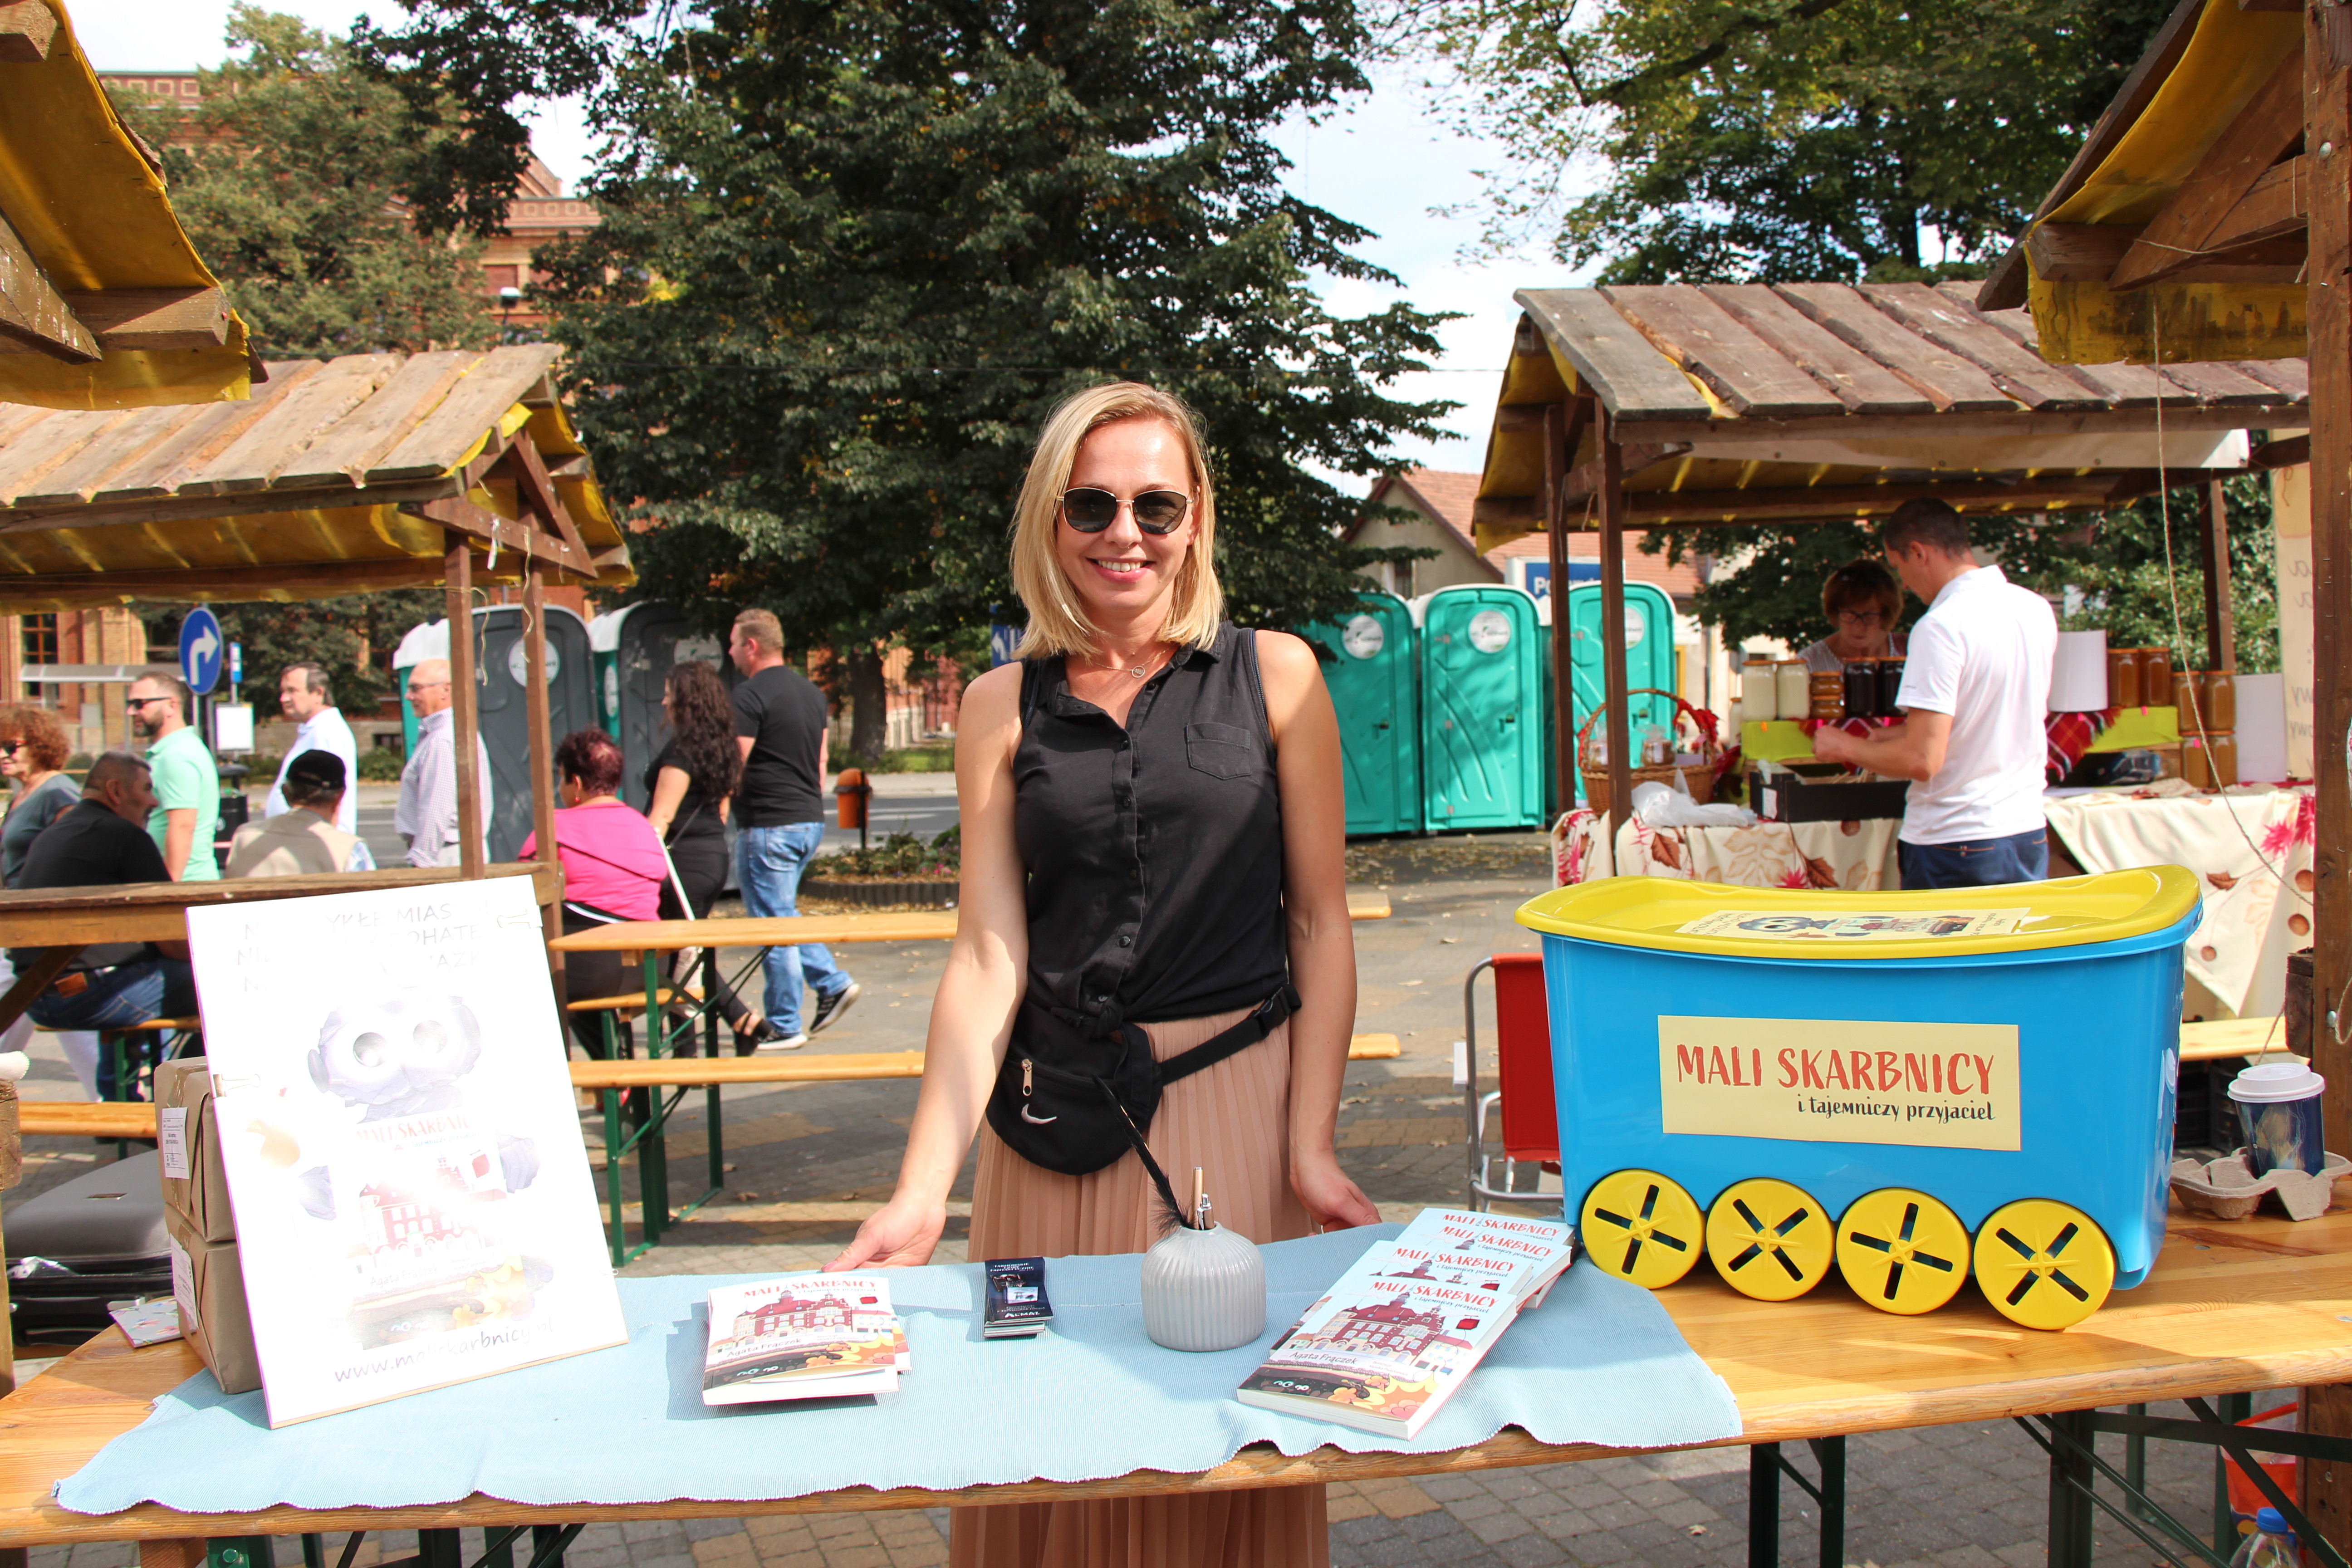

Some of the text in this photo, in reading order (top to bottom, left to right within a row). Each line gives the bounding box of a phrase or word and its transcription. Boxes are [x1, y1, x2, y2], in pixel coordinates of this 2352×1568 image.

[1676, 1044, 1994, 1095] MALI SKARBNICY
[1797, 1094, 1995, 1124] i tajemniczy przyjaciel
[397, 1116, 472, 1139] SKARBNIC
[1442, 1214, 1476, 1225] MALI
[1481, 1219, 1560, 1237] SKARBNICY
[1440, 1226, 1555, 1257] MALI SKARBNICY
[1393, 1248, 1519, 1272] MALI SKARBNICY
[1481, 1244, 1513, 1255] tajemniczy
[1513, 1250, 1544, 1262] przyjaciel
[370, 1273, 400, 1289] Agata
[1441, 1264, 1475, 1274] tajemniczy
[1475, 1268, 1509, 1278] przyjaciel
[791, 1280, 877, 1291] SKARBNICY
[1369, 1281, 1500, 1308] MALI SKARBNICY
[1418, 1296, 1453, 1306] tajemniczy
[1455, 1302, 1490, 1313] przyjaciel
[726, 1338, 802, 1357] Agata Frączek
[1289, 1351, 1358, 1365] Agata Frączek
